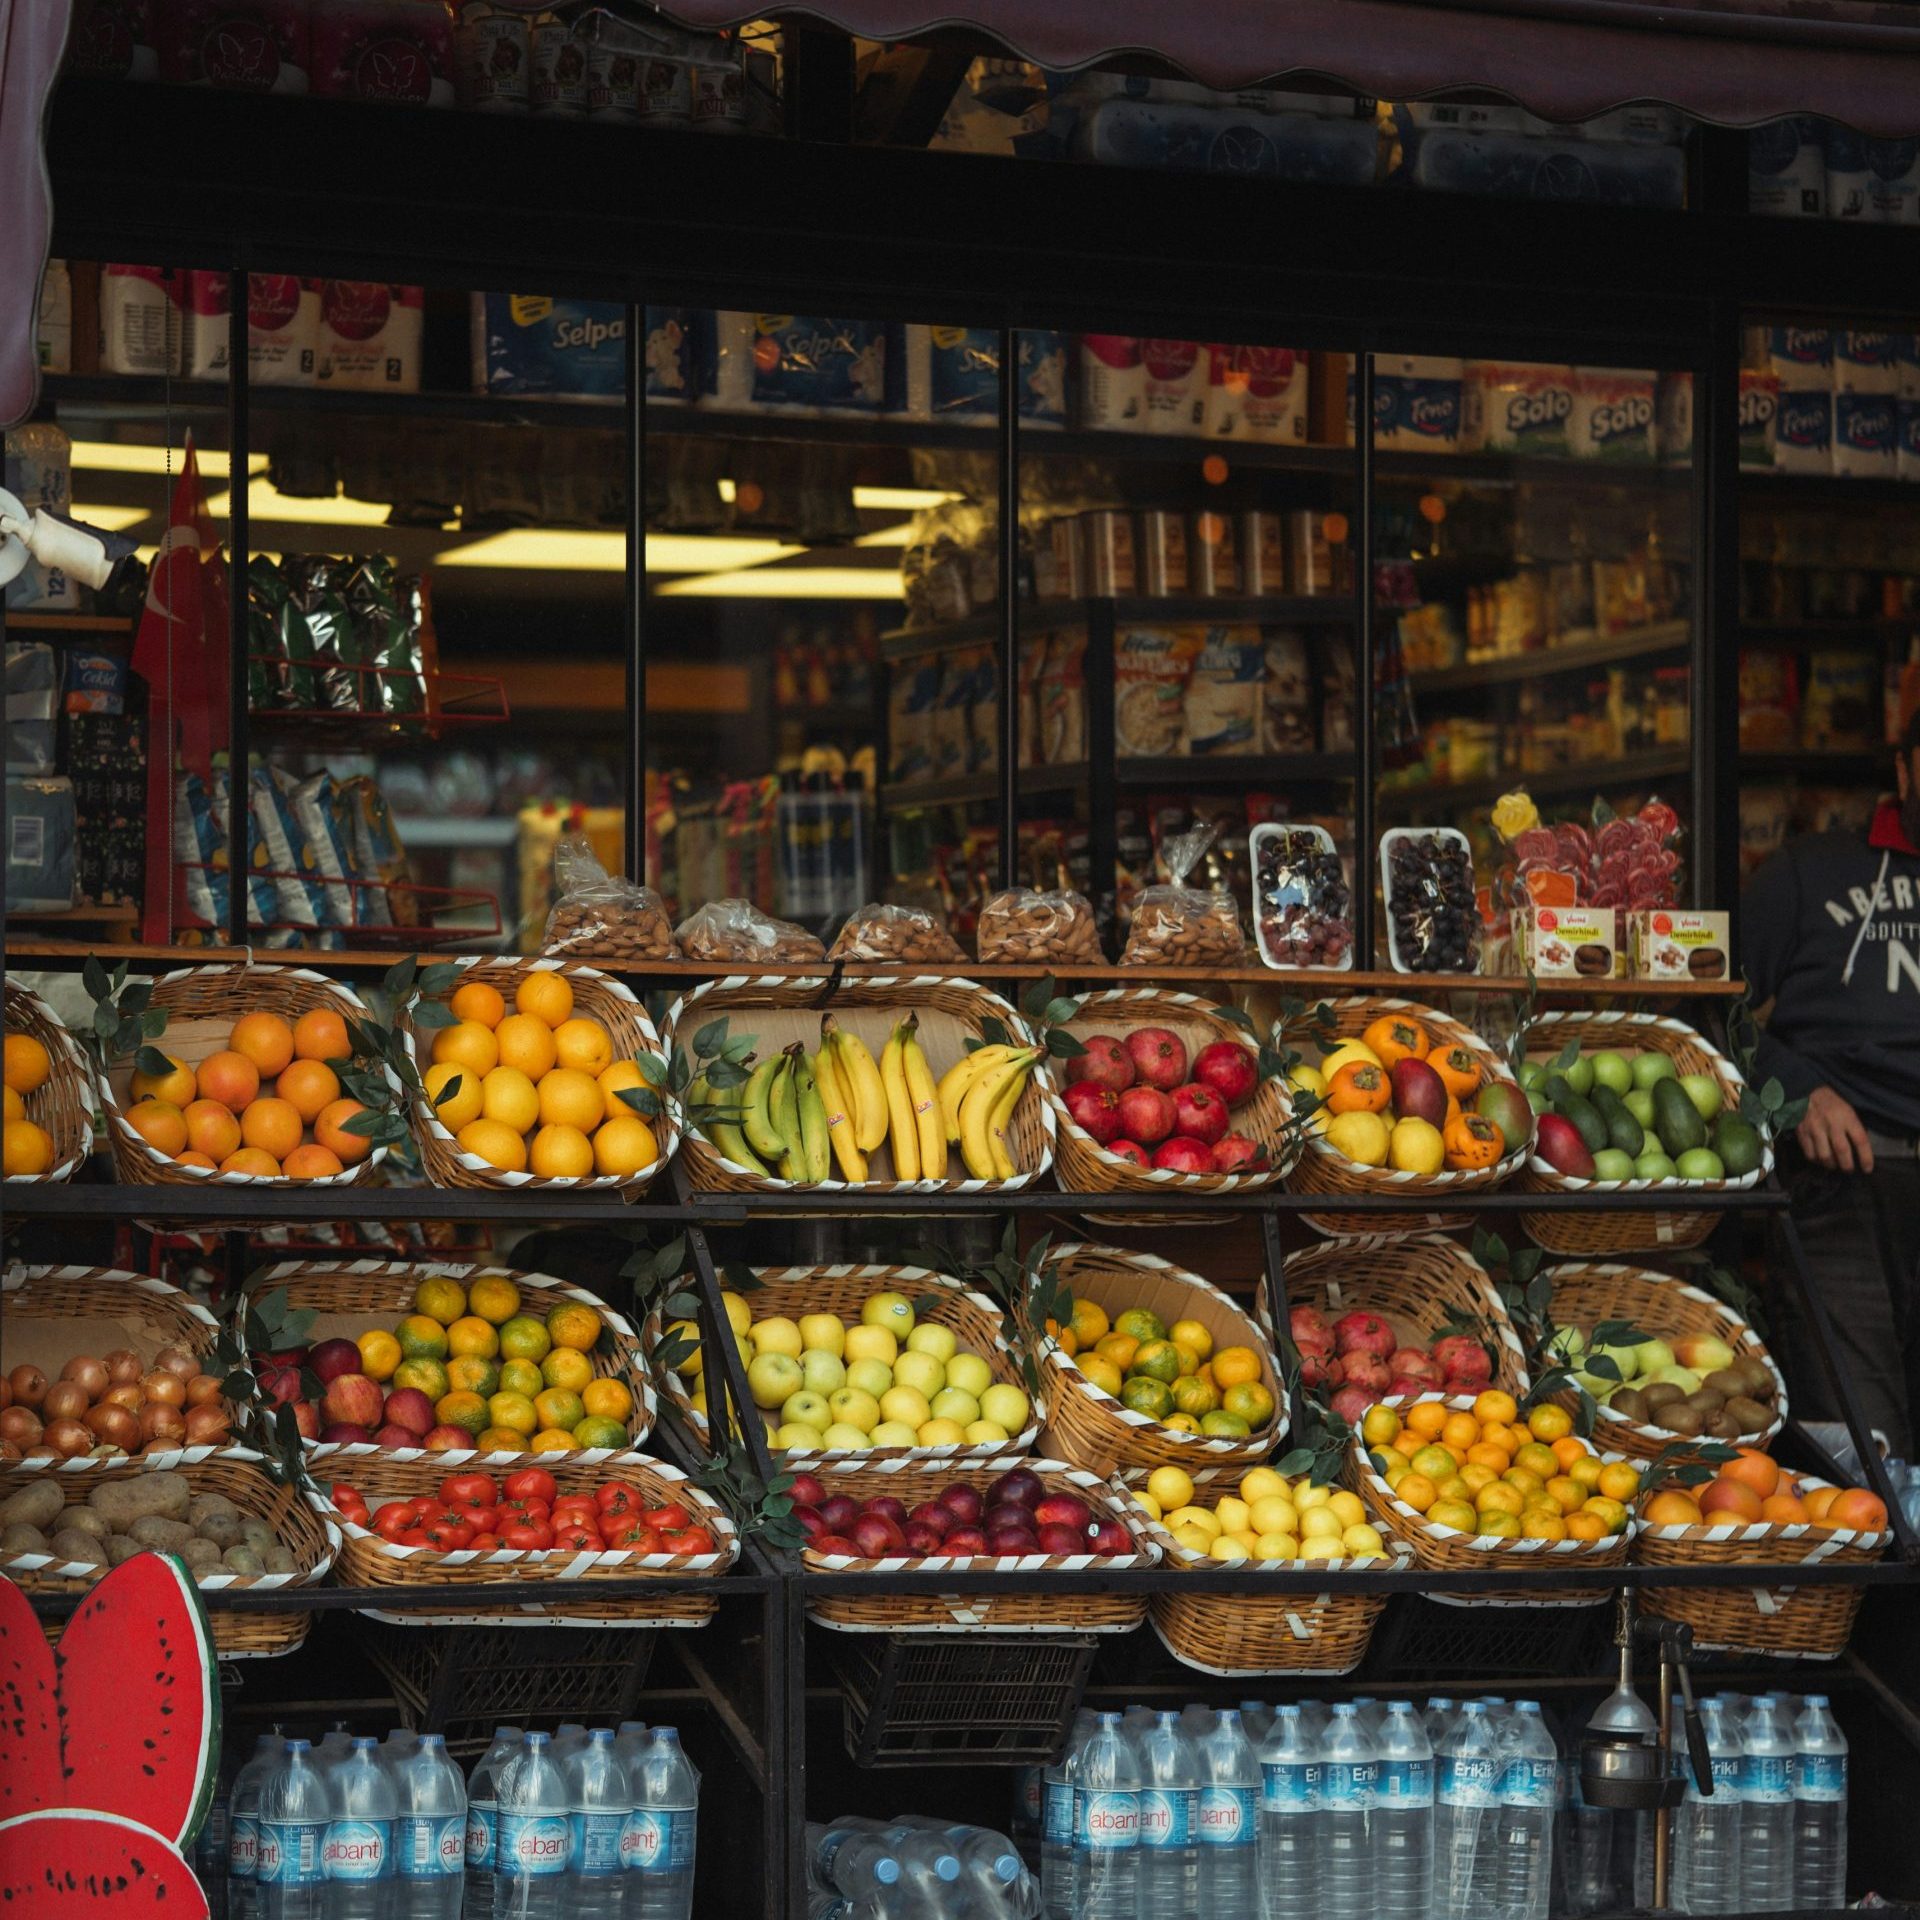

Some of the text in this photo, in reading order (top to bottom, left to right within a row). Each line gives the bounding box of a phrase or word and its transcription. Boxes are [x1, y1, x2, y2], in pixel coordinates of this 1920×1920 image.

[1507, 391, 1571, 427] Solo
[1590, 400, 1650, 436] Solo
[1824, 874, 1920, 928] ABER
